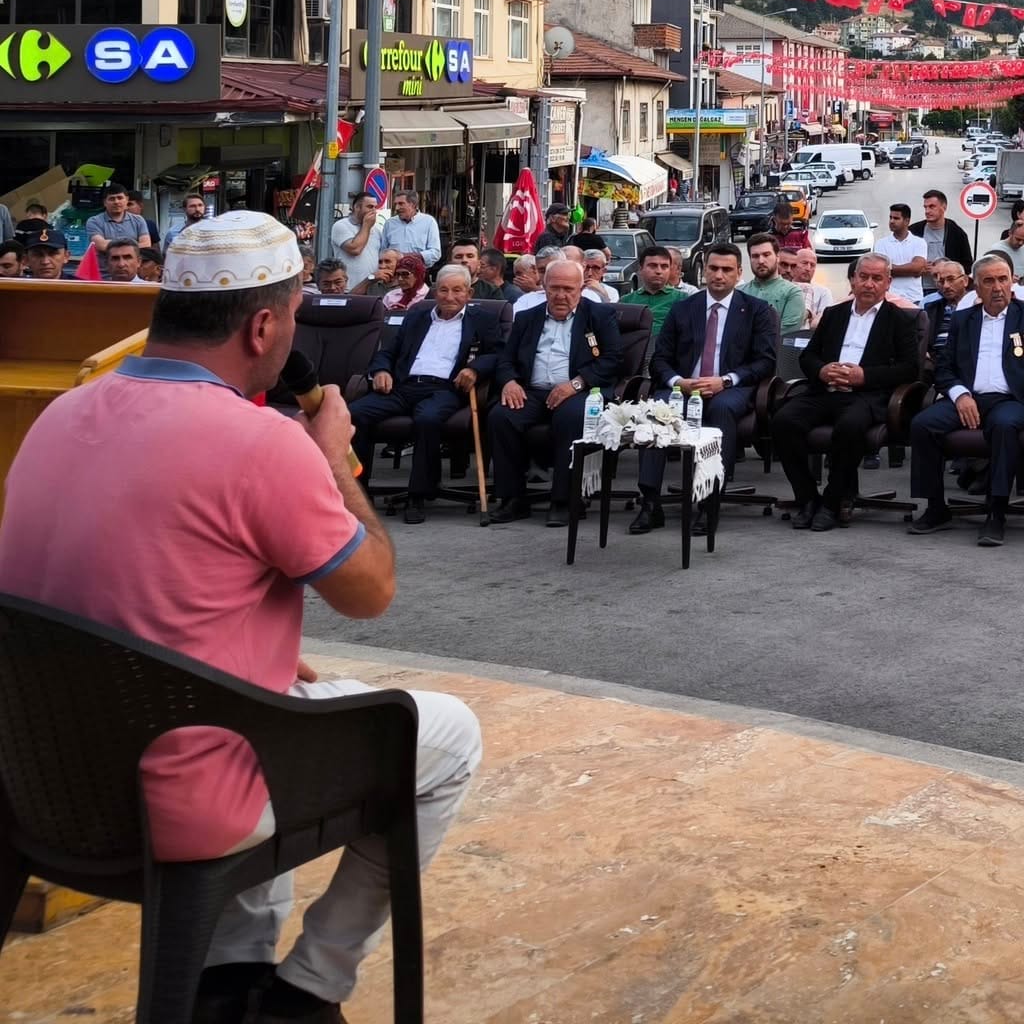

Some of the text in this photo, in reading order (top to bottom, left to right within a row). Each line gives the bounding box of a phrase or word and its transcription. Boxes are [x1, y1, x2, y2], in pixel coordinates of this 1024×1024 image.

[94, 40, 188, 70] SA
[364, 40, 471, 73] rrefour SA
[402, 76, 423, 96] mini
